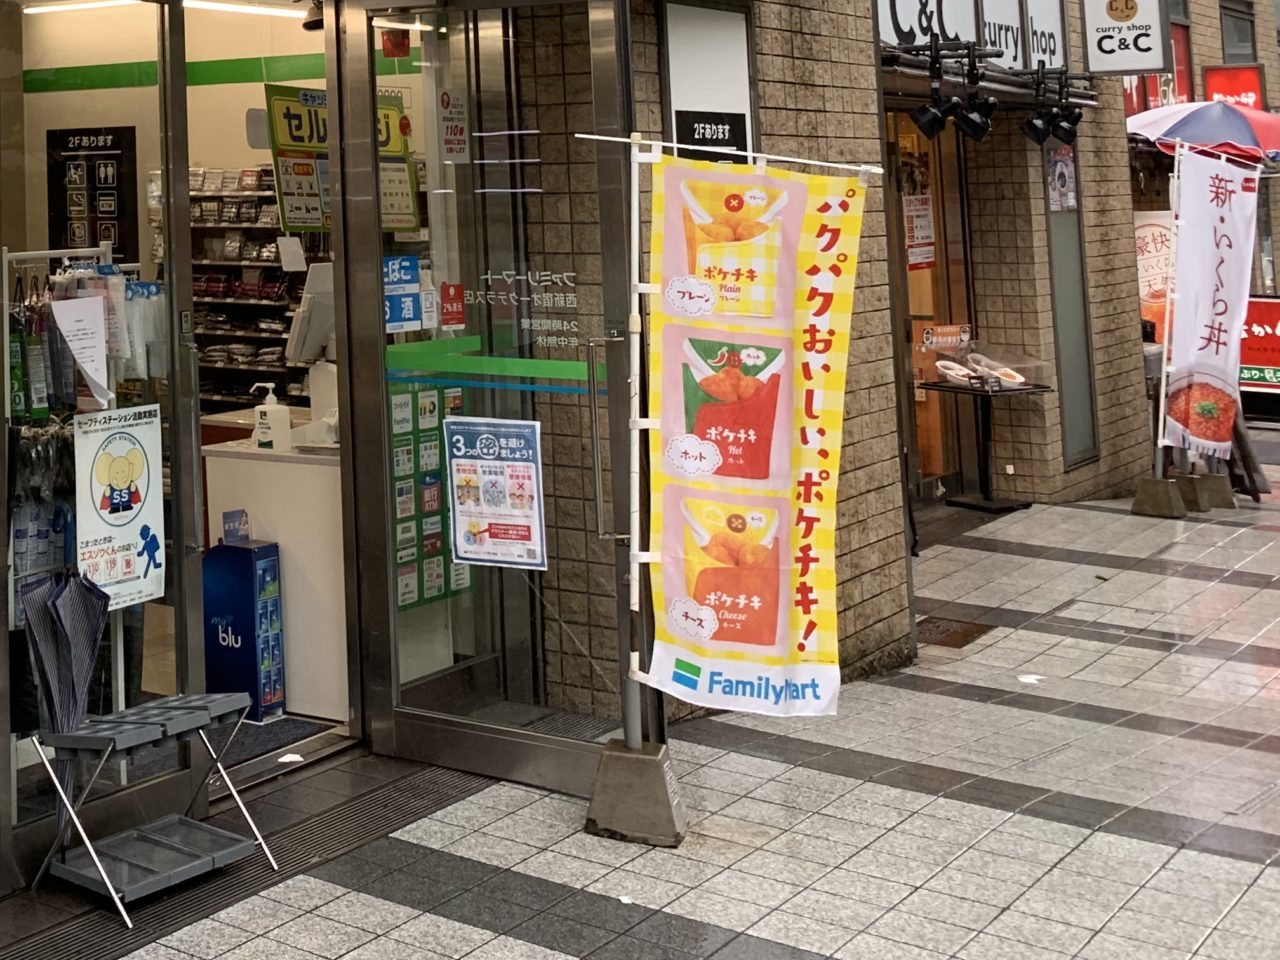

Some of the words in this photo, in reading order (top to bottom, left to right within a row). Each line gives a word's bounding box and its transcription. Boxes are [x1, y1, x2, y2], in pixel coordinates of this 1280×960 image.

[1096, 25, 1123, 34] curry
[1126, 23, 1152, 32] shop
[1097, 33, 1153, 54] C&C
[693, 123, 730, 140] 2Fあります
[68, 135, 114, 148] 2Fあります
[1197, 173, 1237, 355] 新・いくら丼
[703, 266, 758, 282] ポケチキ
[719, 283, 741, 293] Plain
[677, 290, 710, 302] プレーン
[705, 426, 758, 444] ポケチキ
[680, 449, 707, 462] ホット
[727, 445, 743, 456] Hot
[113, 490, 129, 503] SS
[705, 591, 762, 610] ポケチキ
[719, 609, 748, 621] Cheese
[219, 626, 242, 648] blu
